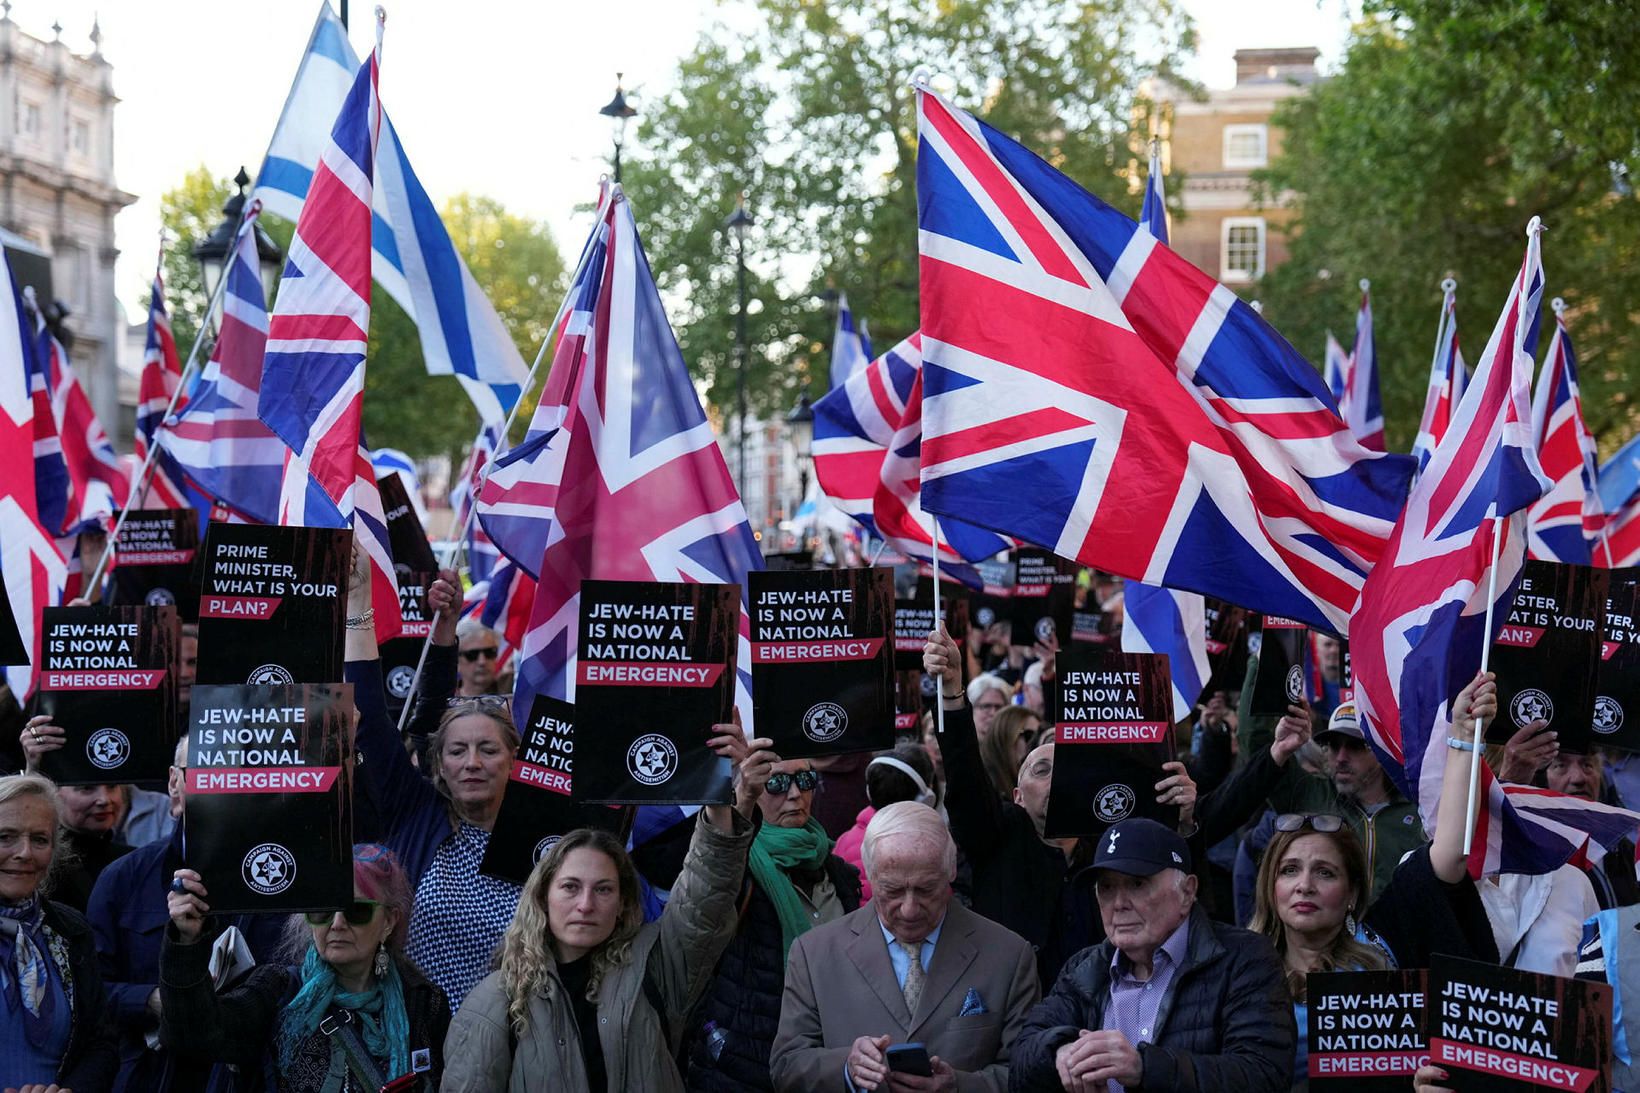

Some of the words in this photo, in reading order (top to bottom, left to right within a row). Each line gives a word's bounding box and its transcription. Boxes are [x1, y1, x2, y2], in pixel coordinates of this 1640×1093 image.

[387, 504, 409, 520] OUR
[121, 520, 177, 532] EW-HATE
[131, 531, 160, 541] NOW
[161, 530, 171, 540] A
[119, 541, 177, 552] NATIONAL
[216, 544, 269, 559] PRIME
[119, 552, 187, 565] EMERGENCY
[213, 561, 298, 581] MINISTER,
[213, 579, 266, 594] WHAT
[270, 582, 285, 595] IS
[290, 582, 338, 598] YOUR
[757, 589, 853, 605] JEW-HATE
[209, 599, 269, 615] PLAN?
[588, 603, 695, 621] JEW-HATE
[758, 608, 775, 622] IS
[780, 607, 826, 622] NOW
[831, 607, 845, 621] A
[895, 608, 947, 619] JEW-HAE
[1508, 610, 1531, 624] AT
[1534, 613, 1548, 626] IS
[1552, 615, 1596, 632] YOUR
[49, 623, 139, 637] JEW-HATE
[588, 623, 607, 639] IS
[612, 623, 665, 640] NOW
[669, 625, 684, 641] A
[759, 624, 854, 640] NATIONAL
[1498, 628, 1533, 644] AN?
[1610, 629, 1624, 641] IS
[50, 640, 65, 653] IS
[70, 639, 113, 653] NOW
[117, 639, 130, 652] A
[587, 643, 692, 661] NATIONAL
[759, 642, 871, 660] EMERGENCY
[49, 656, 138, 669] NATIONAL
[49, 673, 153, 688] EMERGENCY
[586, 665, 710, 683] EMERGENCY
[1063, 671, 1141, 685] JEW-HATE
[1064, 689, 1078, 703] IS
[1082, 688, 1121, 702] NOW
[1125, 689, 1136, 702] A
[198, 707, 306, 725] JEW-HATE
[1064, 706, 1145, 721] NATIONAL
[534, 715, 574, 737] JEW-
[1063, 725, 1159, 740] EMERGENCY
[198, 728, 217, 745] IS
[222, 728, 275, 745] NOW
[280, 727, 296, 744] A
[530, 731, 547, 746] IS
[549, 737, 574, 754] NO
[197, 749, 305, 766] NATIONAL
[525, 748, 573, 773] NATIO
[196, 771, 325, 790] EMERGENCY
[519, 765, 572, 792] EMERG
[245, 846, 271, 868] CAMPAIGN
[272, 846, 293, 866] AGAINST
[250, 879, 289, 892] ANTISEMITISM
[1316, 992, 1425, 1011] JEW-HATE
[1441, 980, 1560, 1018] JEW-HATE
[1317, 1015, 1336, 1030] IS
[1341, 1013, 1394, 1030] NOW
[1400, 1013, 1416, 1028] A
[1442, 1000, 1461, 1019] IS
[1467, 1005, 1525, 1031] NOW
[1530, 1019, 1548, 1036] A
[1318, 1033, 1426, 1051] NATIONAL
[1442, 1021, 1559, 1060] NATIONAL
[1318, 1055, 1432, 1073] EMERGENC
[1442, 1044, 1580, 1087] EMERGENCY
